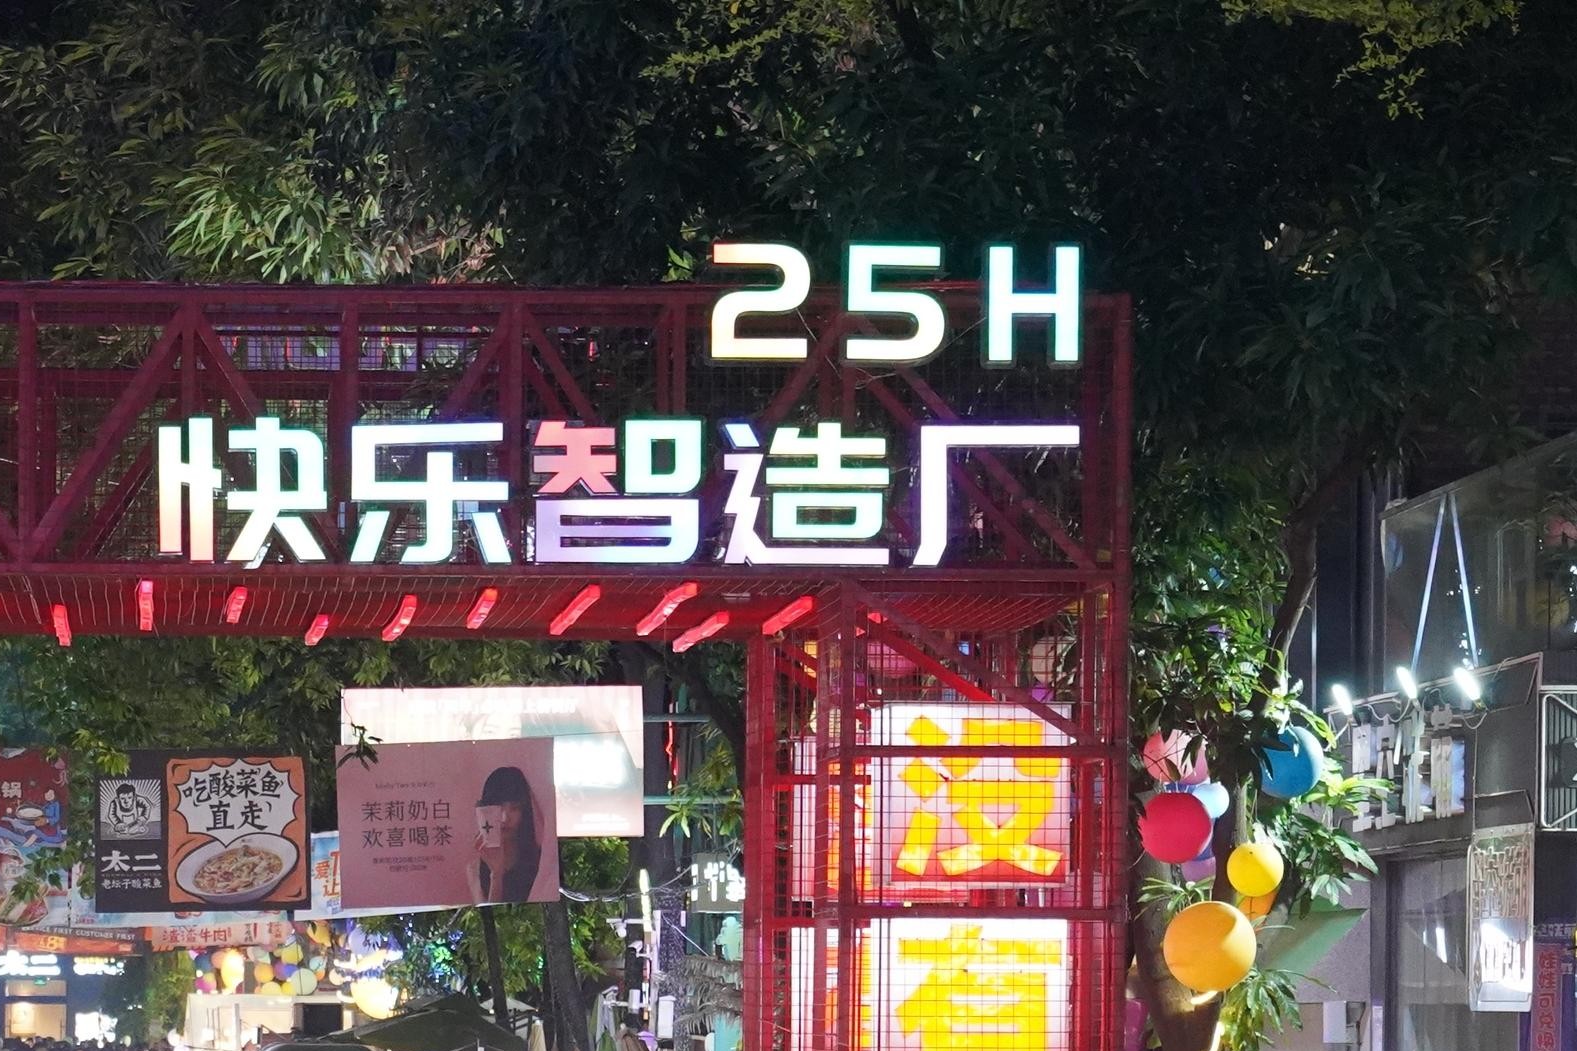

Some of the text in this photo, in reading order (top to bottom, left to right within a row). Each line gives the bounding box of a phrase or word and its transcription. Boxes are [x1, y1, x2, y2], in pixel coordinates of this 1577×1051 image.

[710, 242, 1082, 364] 25H
[156, 414, 1082, 569] 快乐智造厂
[182, 768, 284, 807] 吃酸菜鱼
[206, 801, 273, 832] 直走
[361, 799, 451, 822] 茉莉奶白
[362, 825, 453, 849] 欢喜喝茶
[101, 849, 162, 872] 太二
[101, 878, 163, 890] 老坛子酸菜鱼
